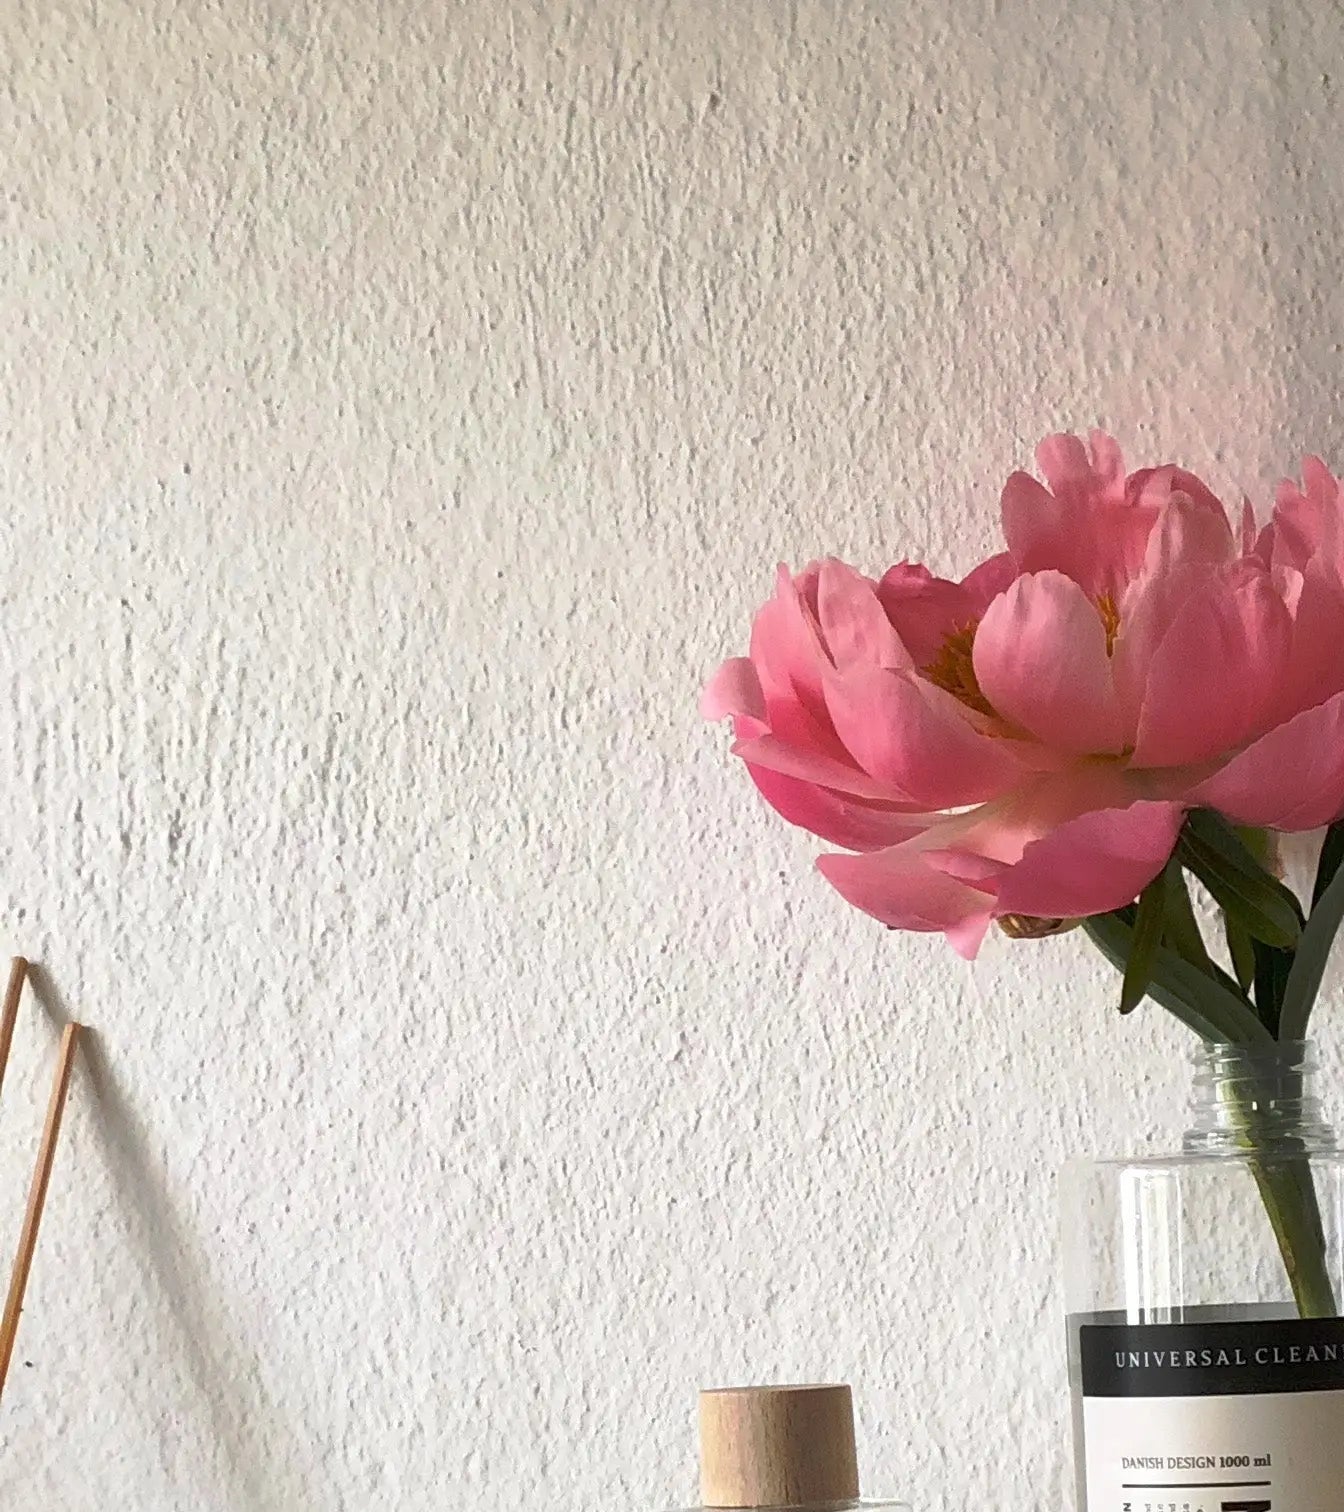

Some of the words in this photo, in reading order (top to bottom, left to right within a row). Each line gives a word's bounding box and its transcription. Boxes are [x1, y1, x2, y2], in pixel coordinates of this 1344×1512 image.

[1115, 1349, 1247, 1368] UNIVERSAL
[1122, 1456, 1164, 1469] DANISH
[1167, 1456, 1216, 1469] DESIGN
[1219, 1456, 1250, 1468] 1000
[1253, 1454, 1271, 1467] ml
